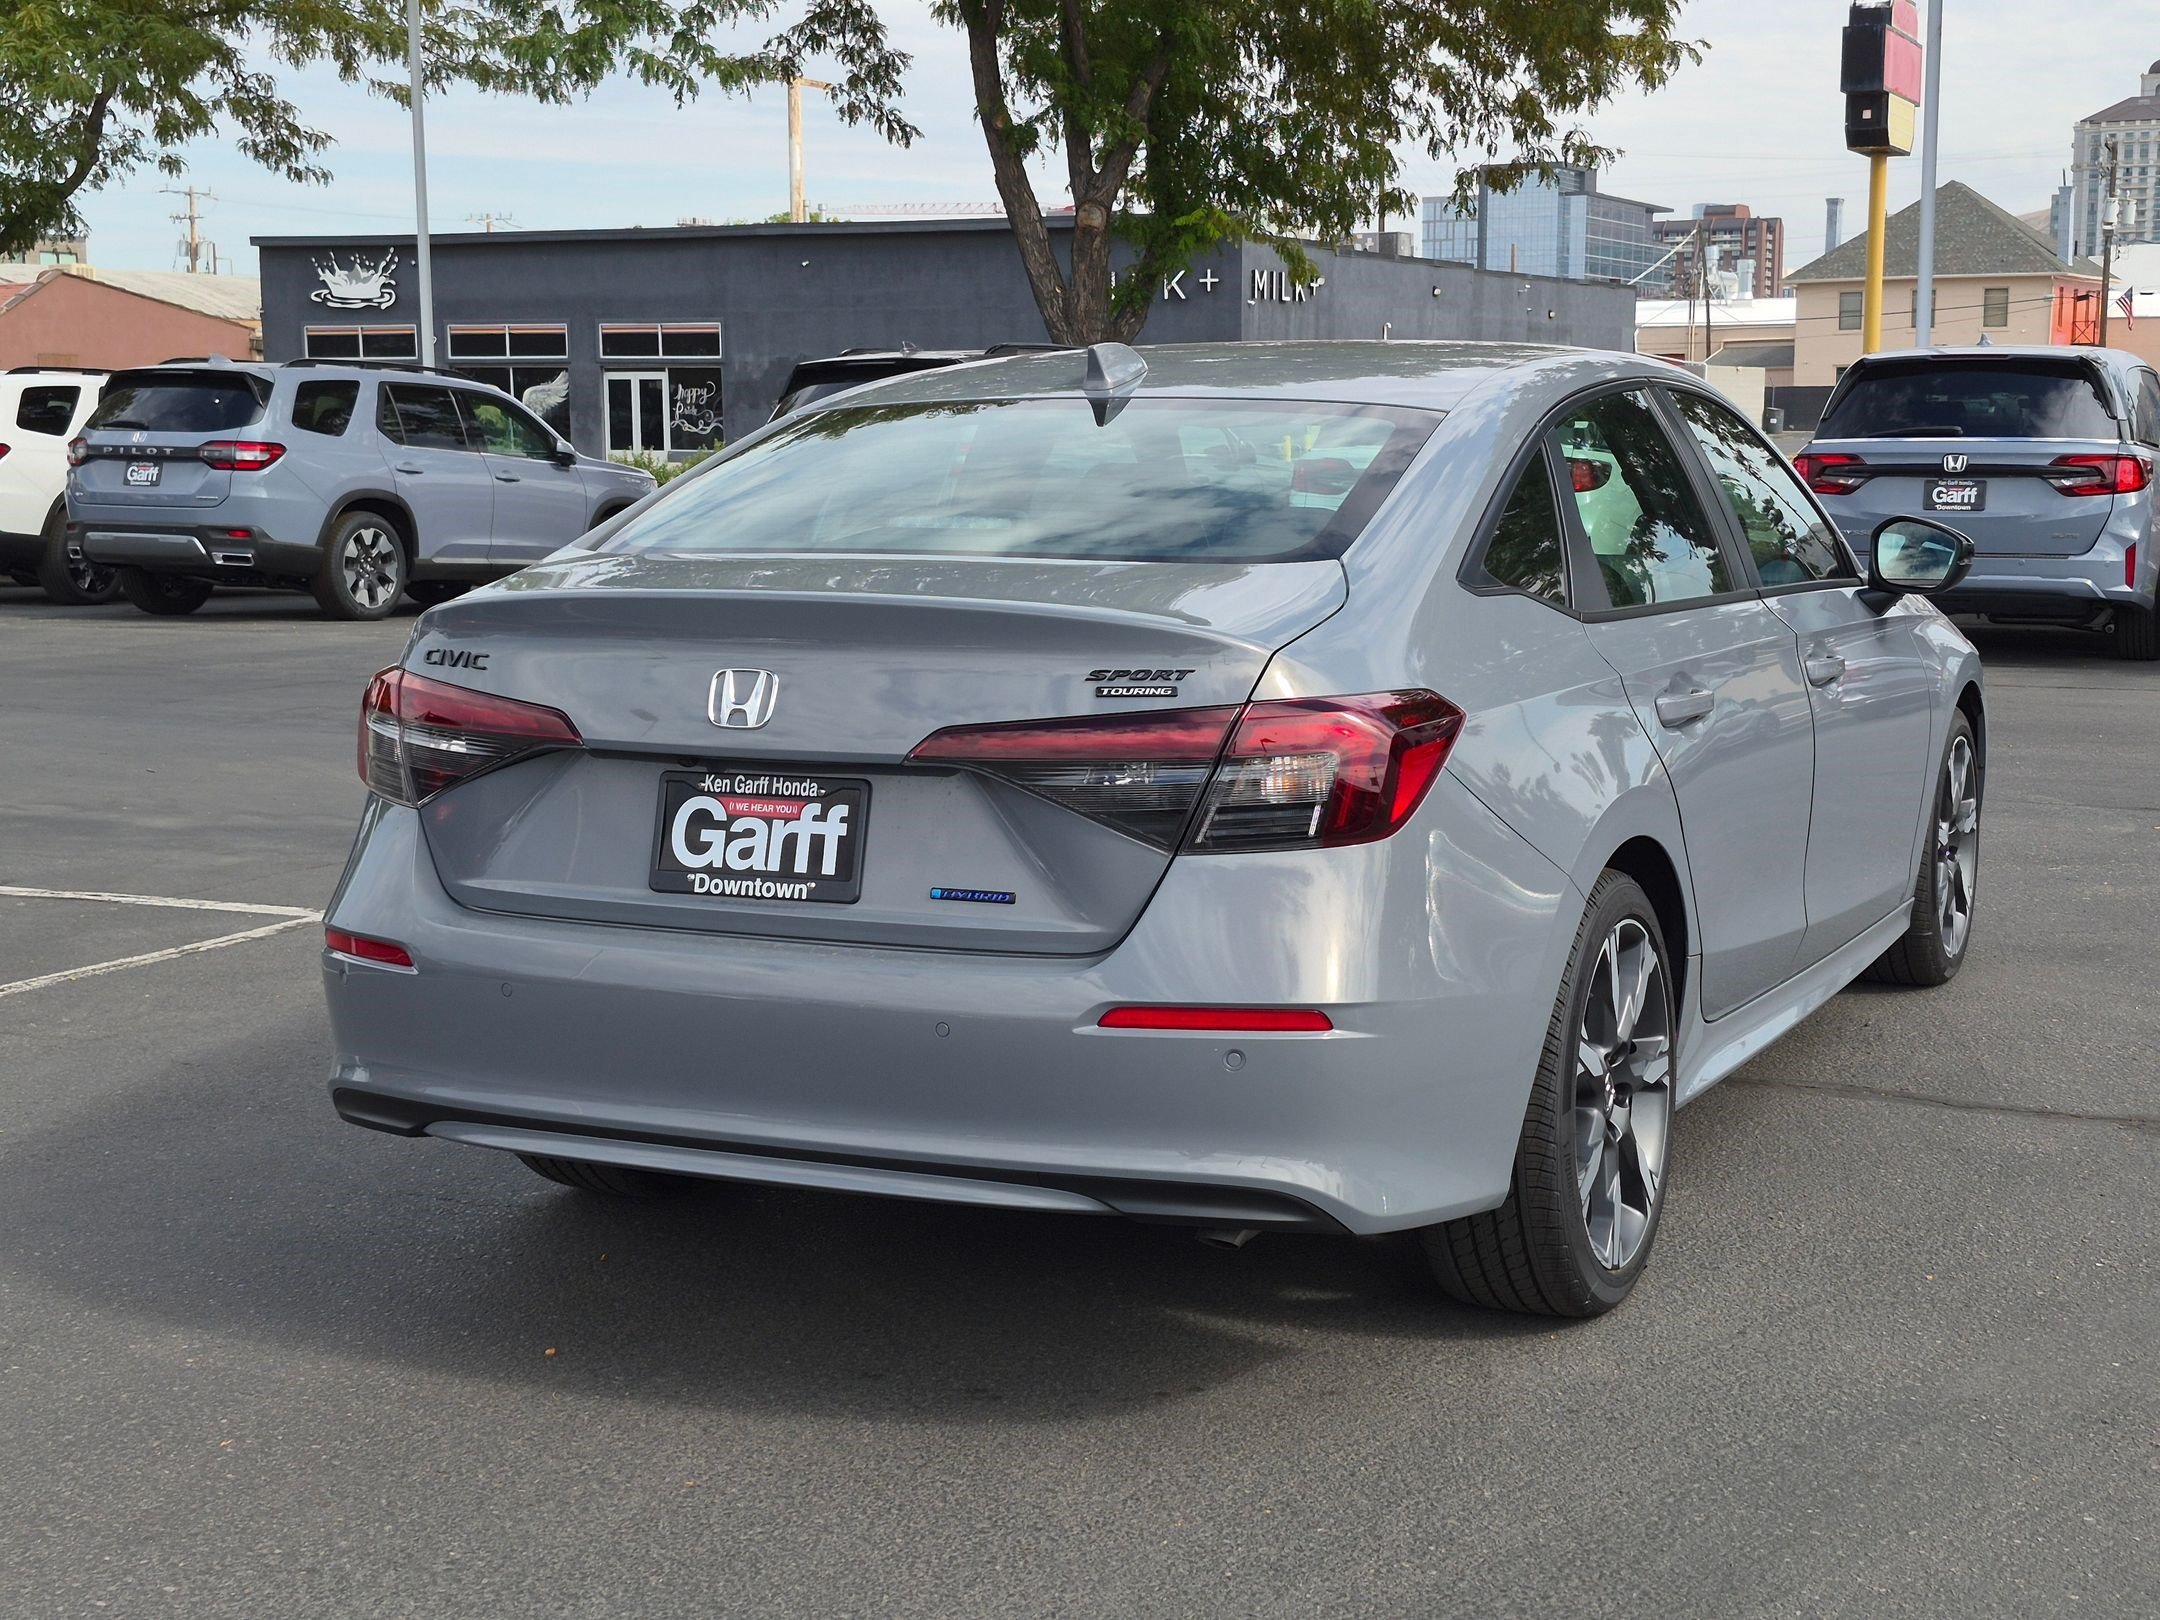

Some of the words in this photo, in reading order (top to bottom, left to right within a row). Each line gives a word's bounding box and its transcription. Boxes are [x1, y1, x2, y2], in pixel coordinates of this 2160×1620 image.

[673, 381, 716, 405] happy
[103, 446, 175, 455] PILOT
[127, 466, 159, 481] Garff
[1932, 486, 1978, 503] Garff
[424, 648, 490, 671] CIVIC
[1084, 669, 1196, 682] SPORT
[1100, 687, 1173, 696] TOURING
[704, 774, 730, 793] Ken
[734, 775, 770, 795] Garff
[772, 778, 818, 797] Honda
[735, 802, 749, 811] WE
[751, 803, 774, 813] HEAR
[775, 804, 792, 814] YOU
[671, 795, 849, 876] Garff
[693, 873, 808, 900] Downtown
[943, 890, 1010, 902] HYBRID
